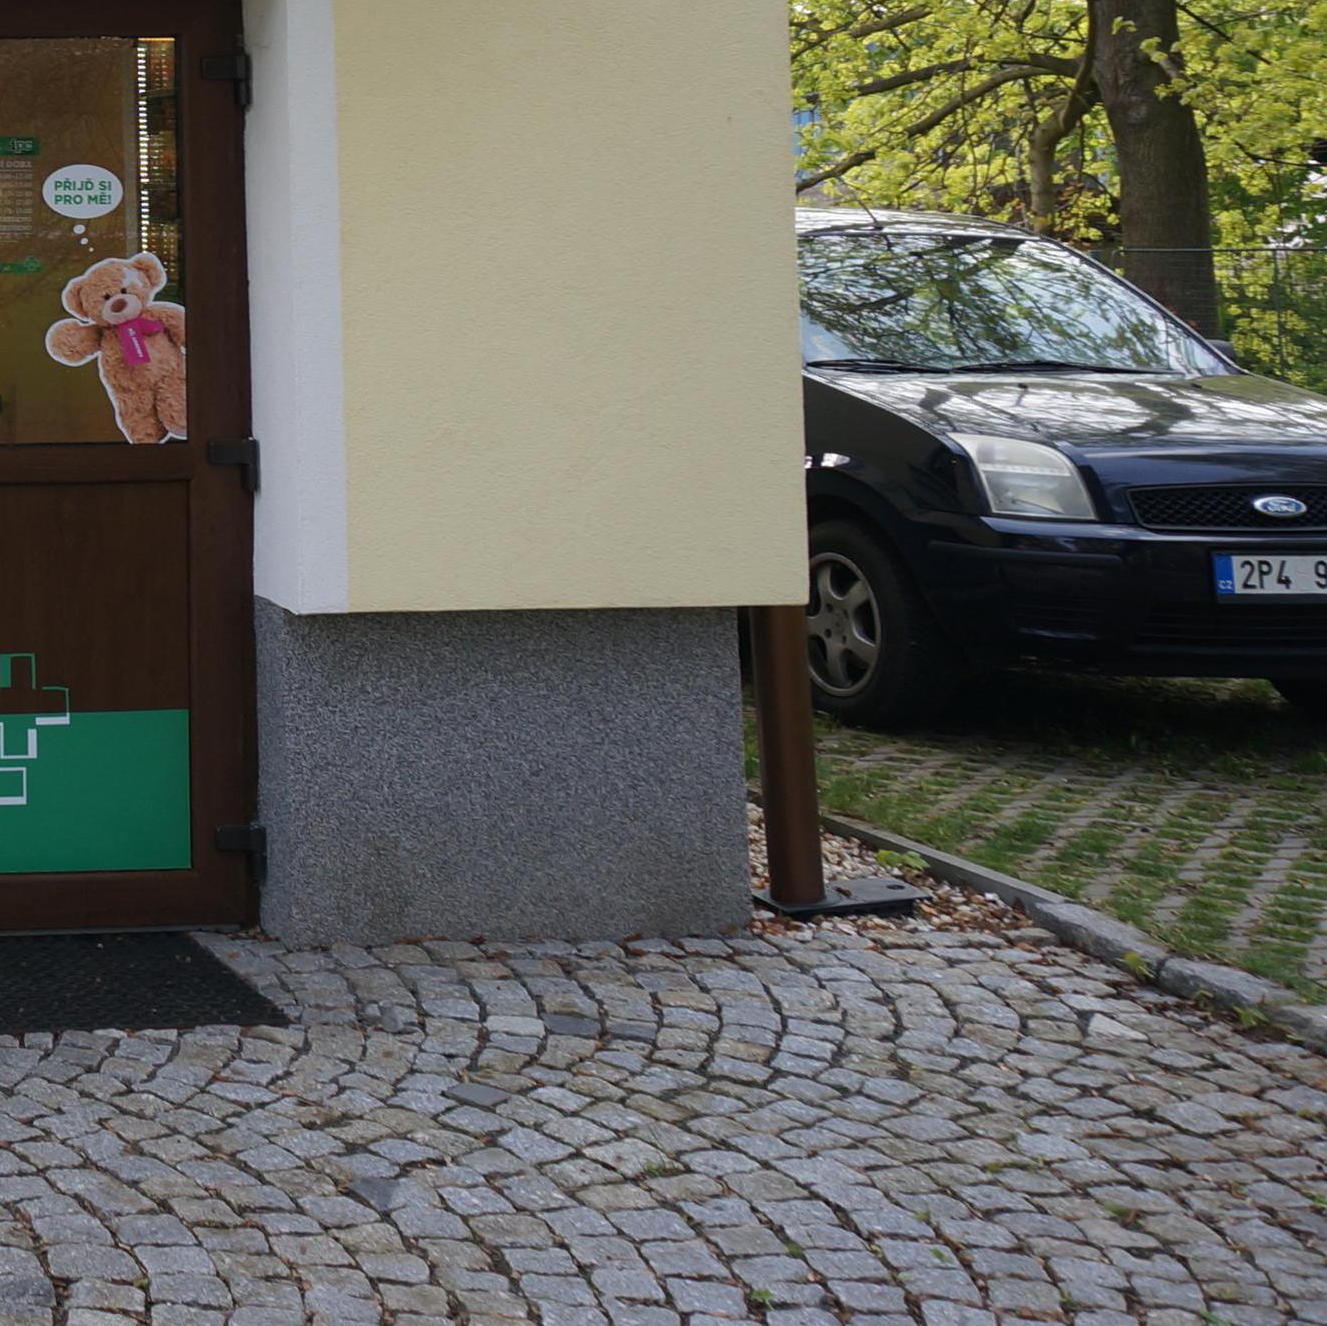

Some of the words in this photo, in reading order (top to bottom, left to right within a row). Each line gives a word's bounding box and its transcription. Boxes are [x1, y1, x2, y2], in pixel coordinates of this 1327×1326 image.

[54, 178, 94, 191] PŘIJĎ
[98, 180, 112, 191] SI
[54, 194, 83, 205] PRO
[87, 192, 112, 205] MĚ!
[1240, 560, 1292, 589] 2P4
[1217, 579, 1233, 590] CZ
